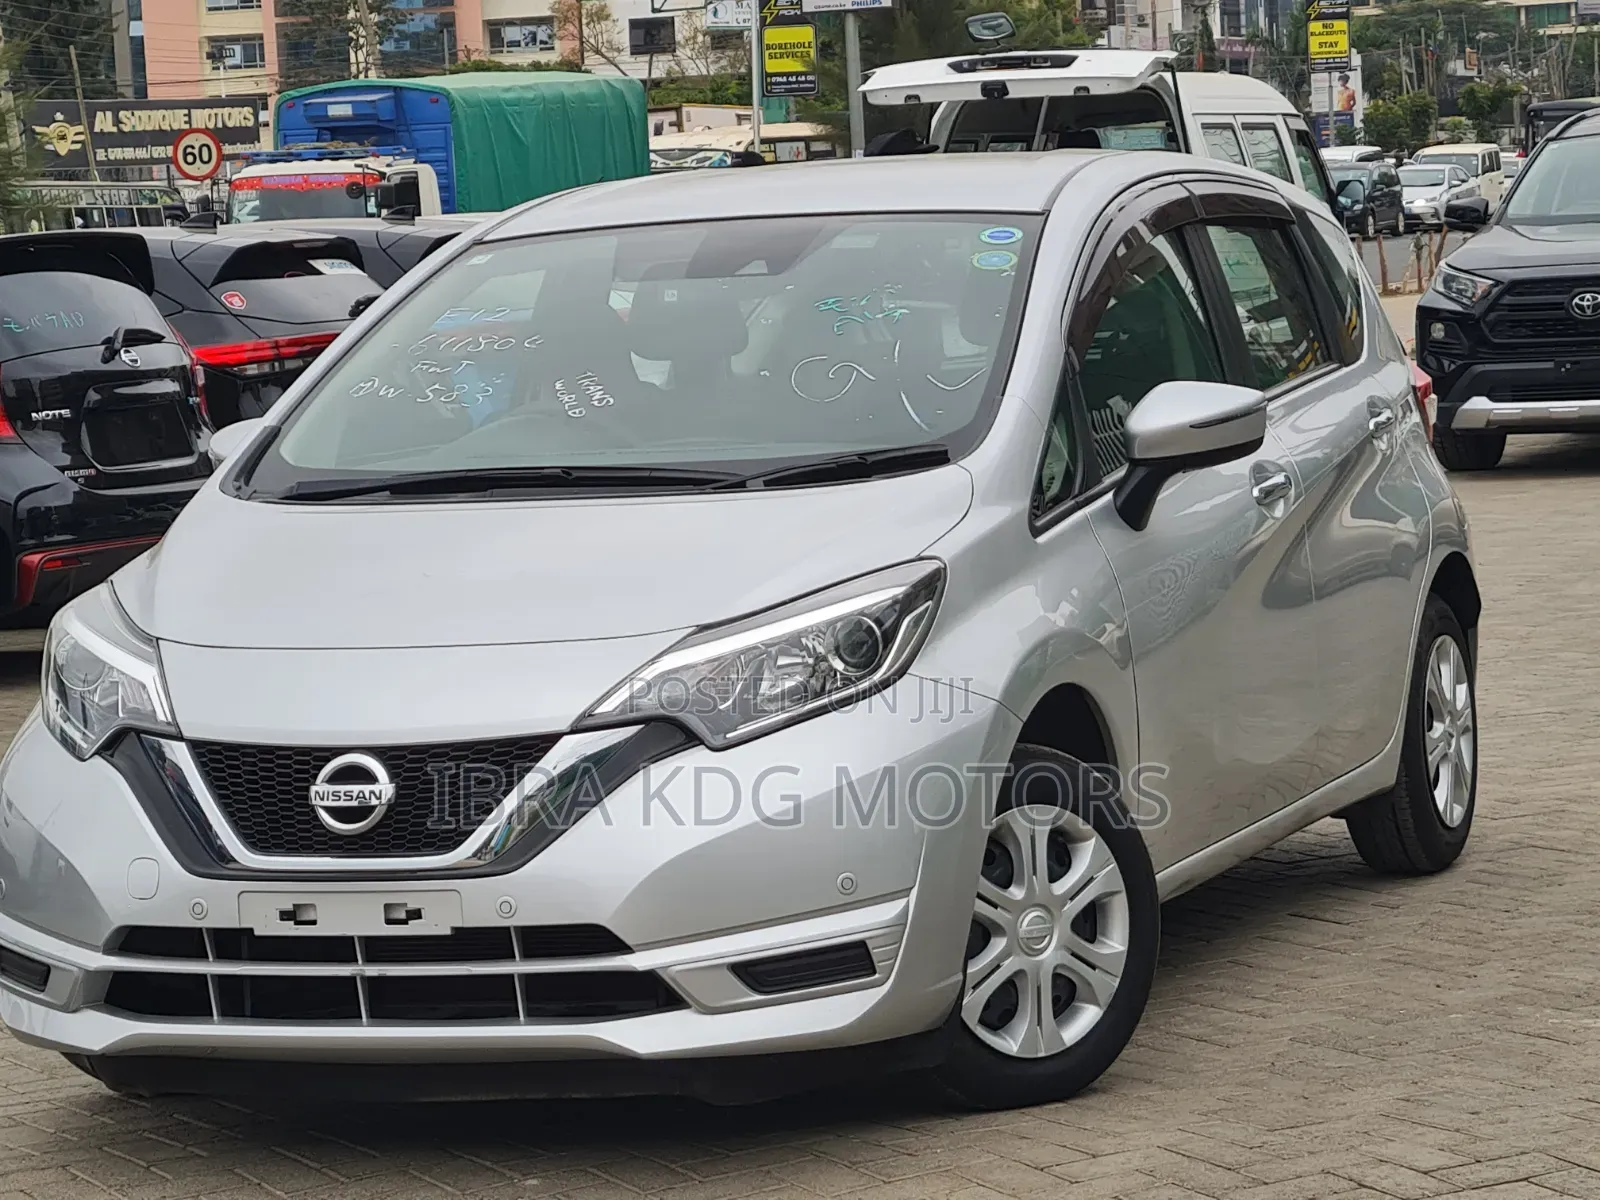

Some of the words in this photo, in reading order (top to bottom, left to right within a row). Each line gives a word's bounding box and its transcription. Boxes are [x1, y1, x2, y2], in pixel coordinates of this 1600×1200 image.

[765, 41, 813, 50] BOREHOLE
[1318, 41, 1339, 49] STAY
[768, 51, 811, 60] SERVICES
[94, 110, 117, 133] AL
[190, 107, 255, 129] MOTORS
[182, 143, 213, 166] 60
[576, 371, 615, 408] TRANS
[554, 379, 587, 418] WORLD
[31, 409, 72, 421] NOTE
[314, 789, 383, 802] NISSAN
